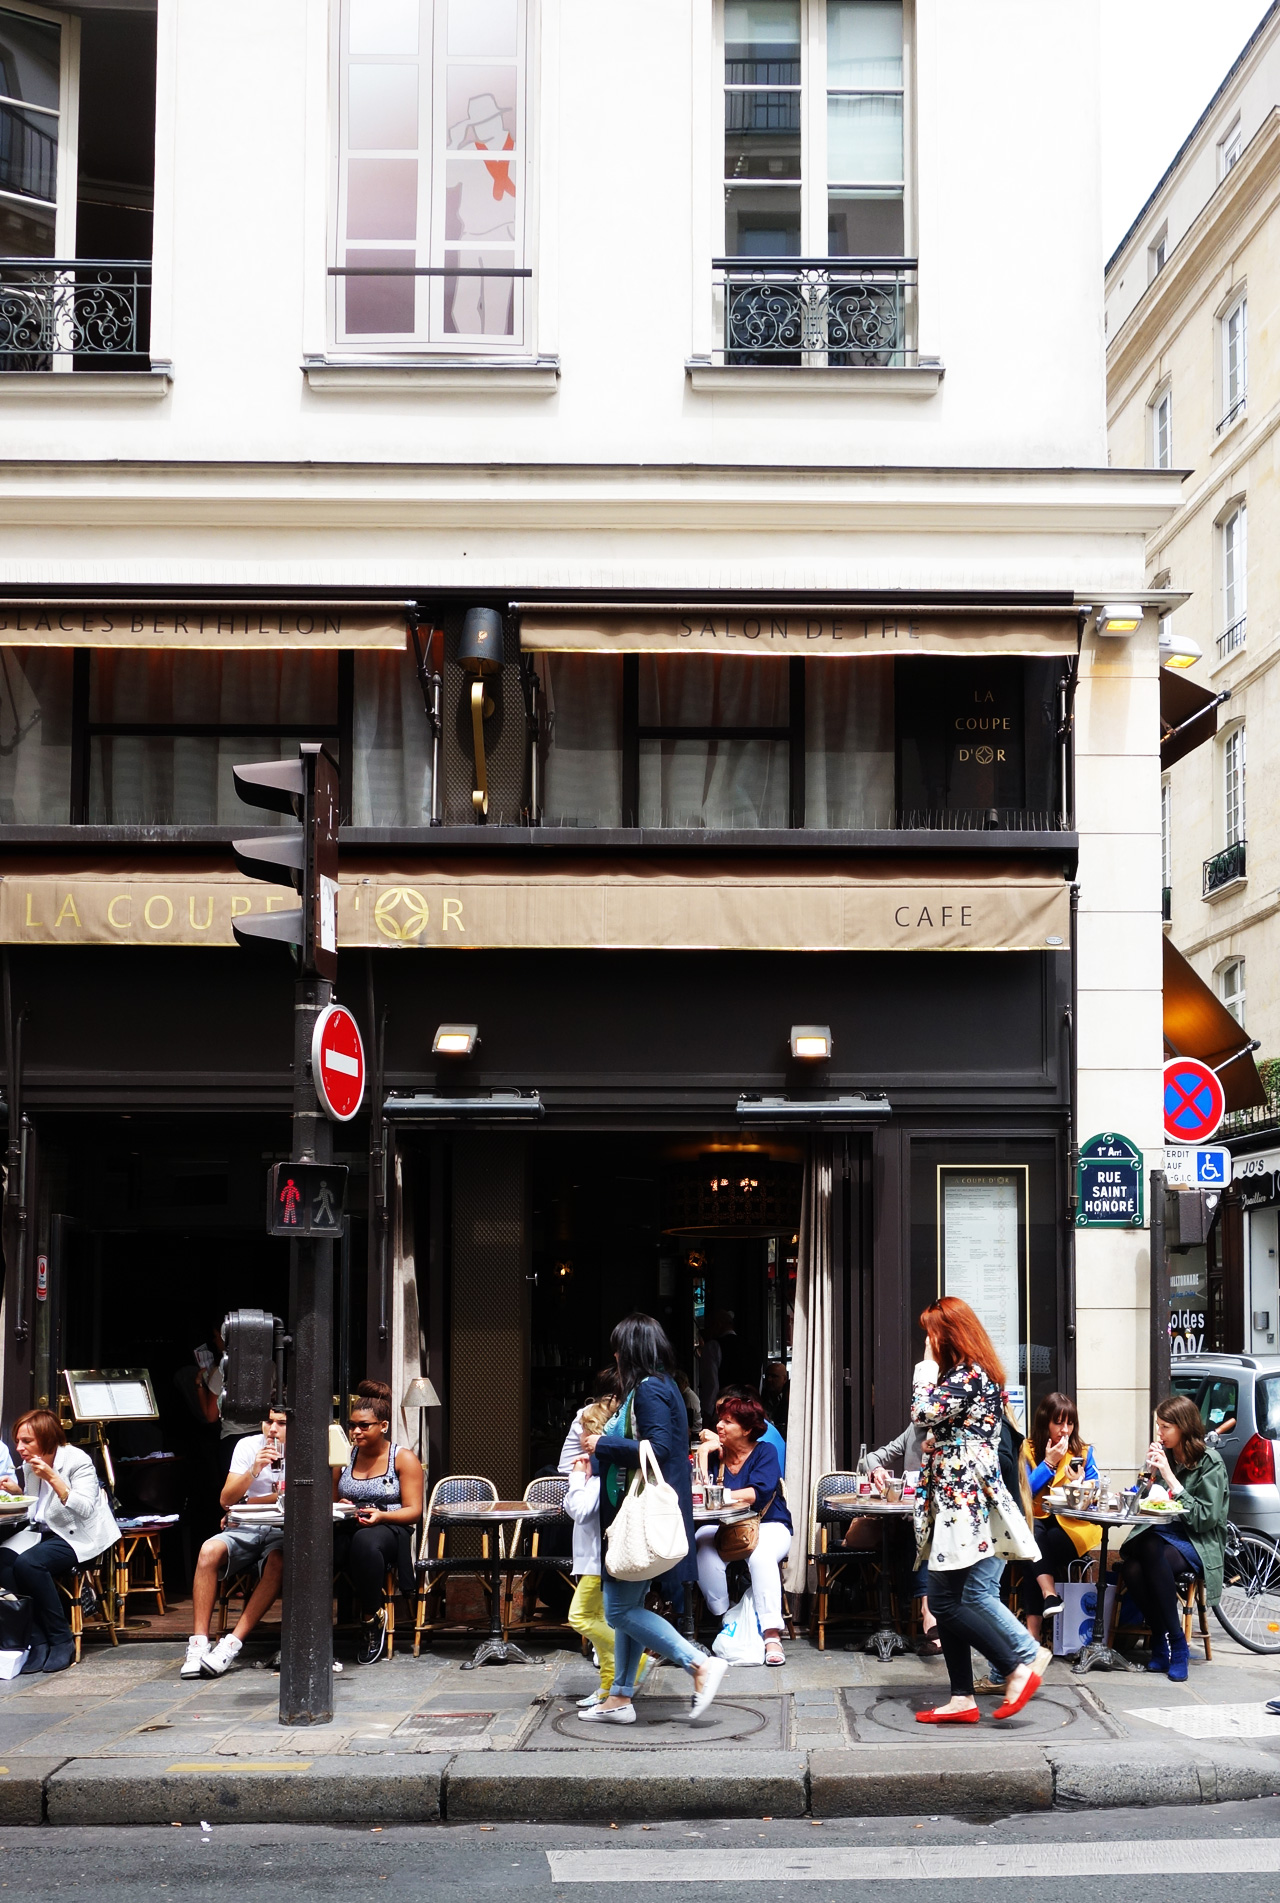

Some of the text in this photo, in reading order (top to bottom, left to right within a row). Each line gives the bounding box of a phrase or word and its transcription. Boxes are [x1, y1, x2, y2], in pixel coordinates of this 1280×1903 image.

[130, 612, 342, 635] BERTHILLON
[680, 616, 920, 640] SALON DE THE
[974, 690, 994, 703] LA
[955, 717, 1011, 730] COUPE
[25, 893, 82, 928] LA
[894, 905, 973, 928] CAFE
[1163, 1150, 1190, 1158] ERDIT
[1164, 1162, 1182, 1170] AUF
[1242, 1159, 1265, 1175] JO'S
[1097, 1171, 1122, 1183] RUE
[1092, 1186, 1127, 1198] SAINT
[1085, 1198, 1135, 1212] HONORÉ
[1171, 1308, 1205, 1328] oldes
